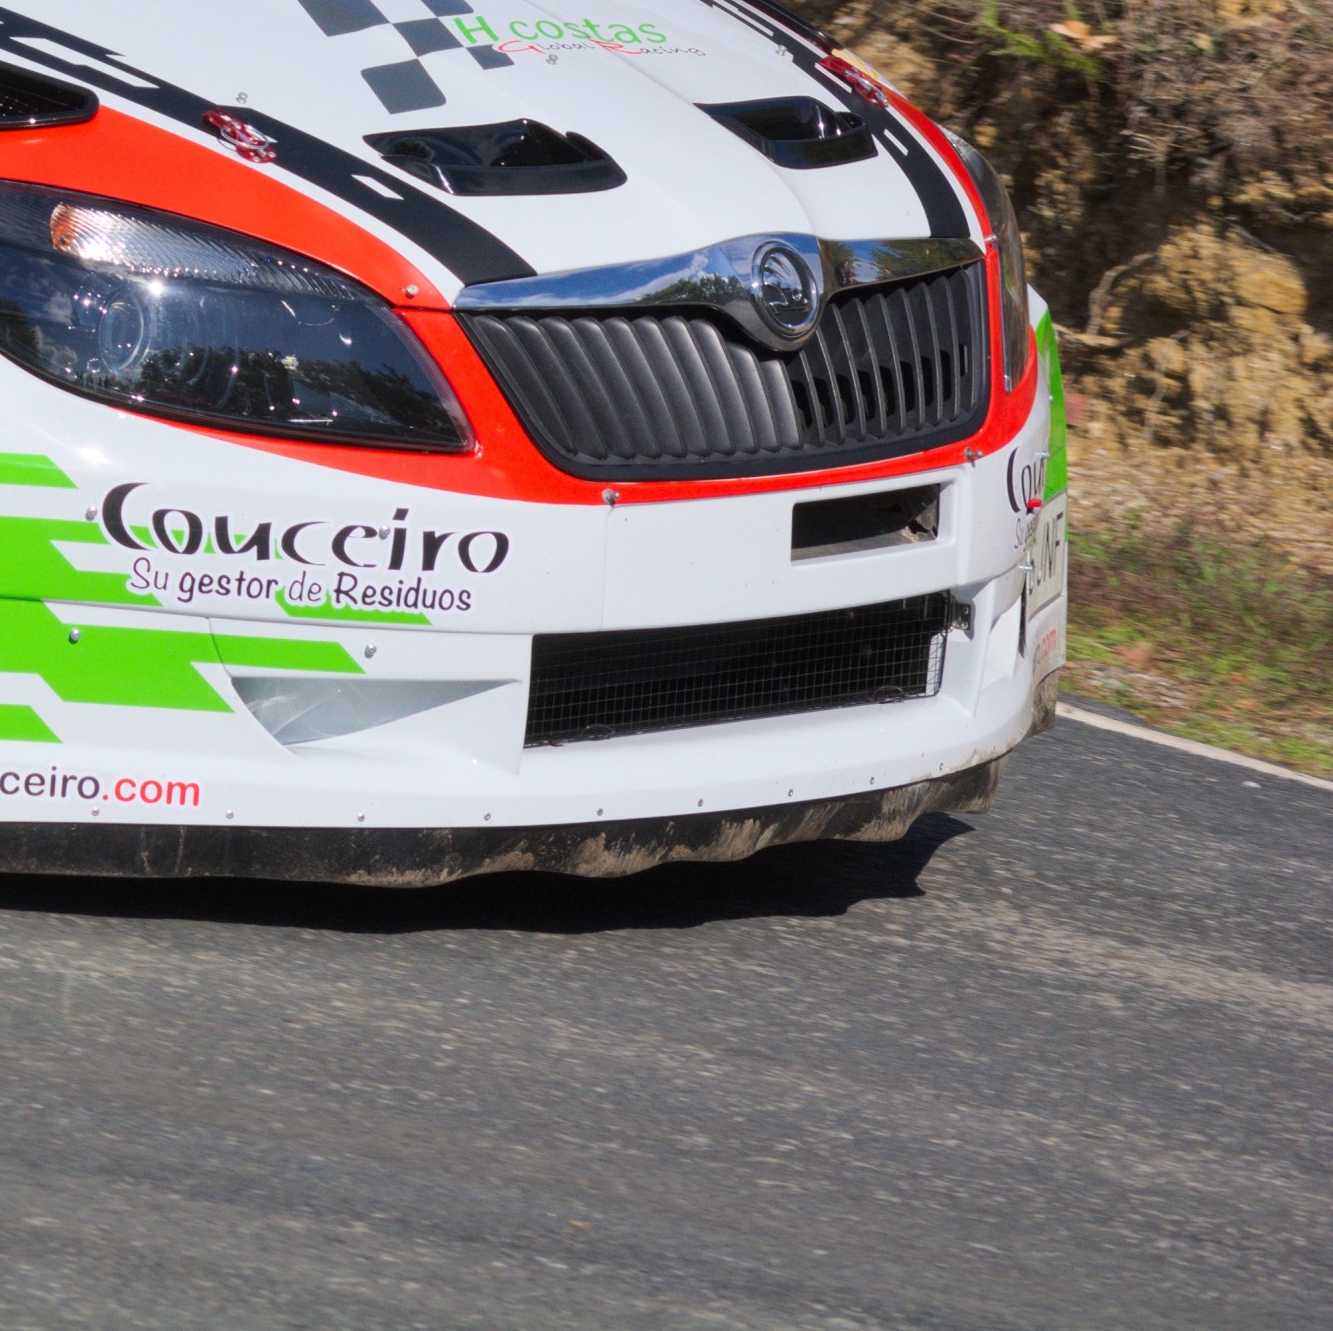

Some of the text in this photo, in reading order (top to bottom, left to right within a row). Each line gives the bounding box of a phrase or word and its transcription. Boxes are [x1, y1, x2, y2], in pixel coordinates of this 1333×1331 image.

[100, 482, 510, 573] Couceiro
[129, 559, 473, 613] Su gestor de Residuos
